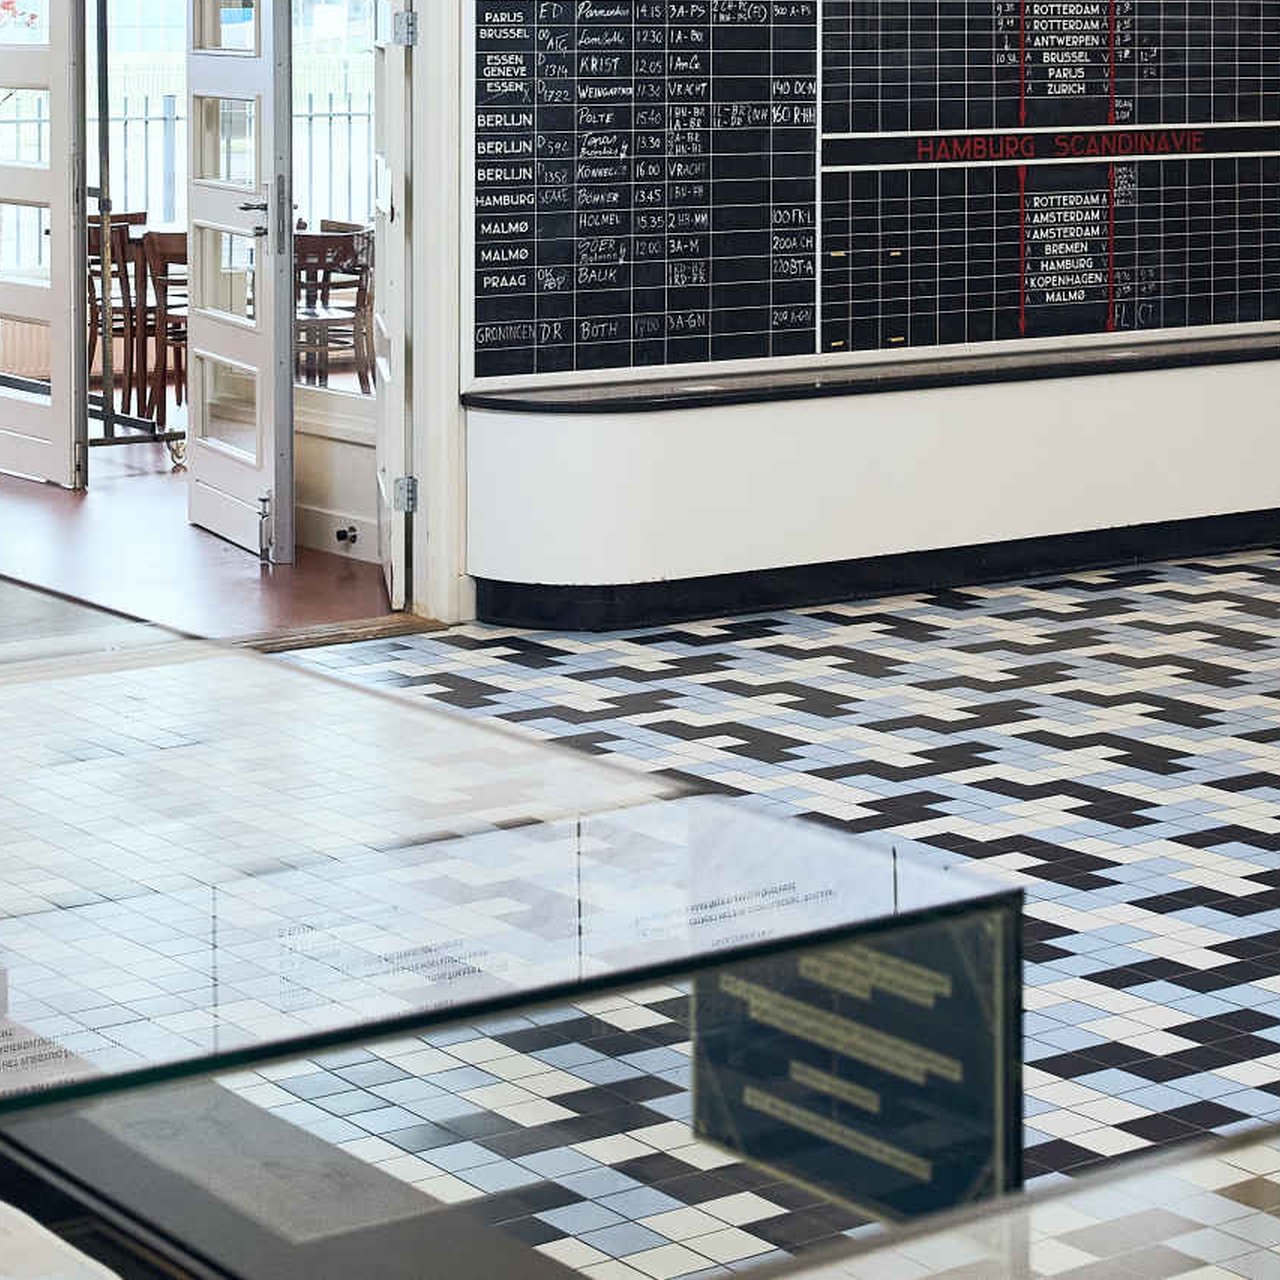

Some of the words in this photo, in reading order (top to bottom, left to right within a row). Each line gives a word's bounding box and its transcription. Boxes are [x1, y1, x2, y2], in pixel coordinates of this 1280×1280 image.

[1033, 35, 1100, 47] ANTWERPEN
[487, 55, 523, 66] ESSEN
[1043, 51, 1091, 63] BRUSSEL
[483, 66, 527, 77] GENEVE
[1047, 82, 1086, 95] ZURICH
[917, 135, 1036, 161] HAMBURG
[1055, 131, 1206, 157] SCANDINAVIE
[475, 193, 535, 207] HAMBURG
[1045, 242, 1088, 255] BREMEN
[1040, 257, 1093, 271] HAMBURG
[483, 274, 527, 288] PRAAG
[1030, 273, 1102, 287] KOPENHAGEN
